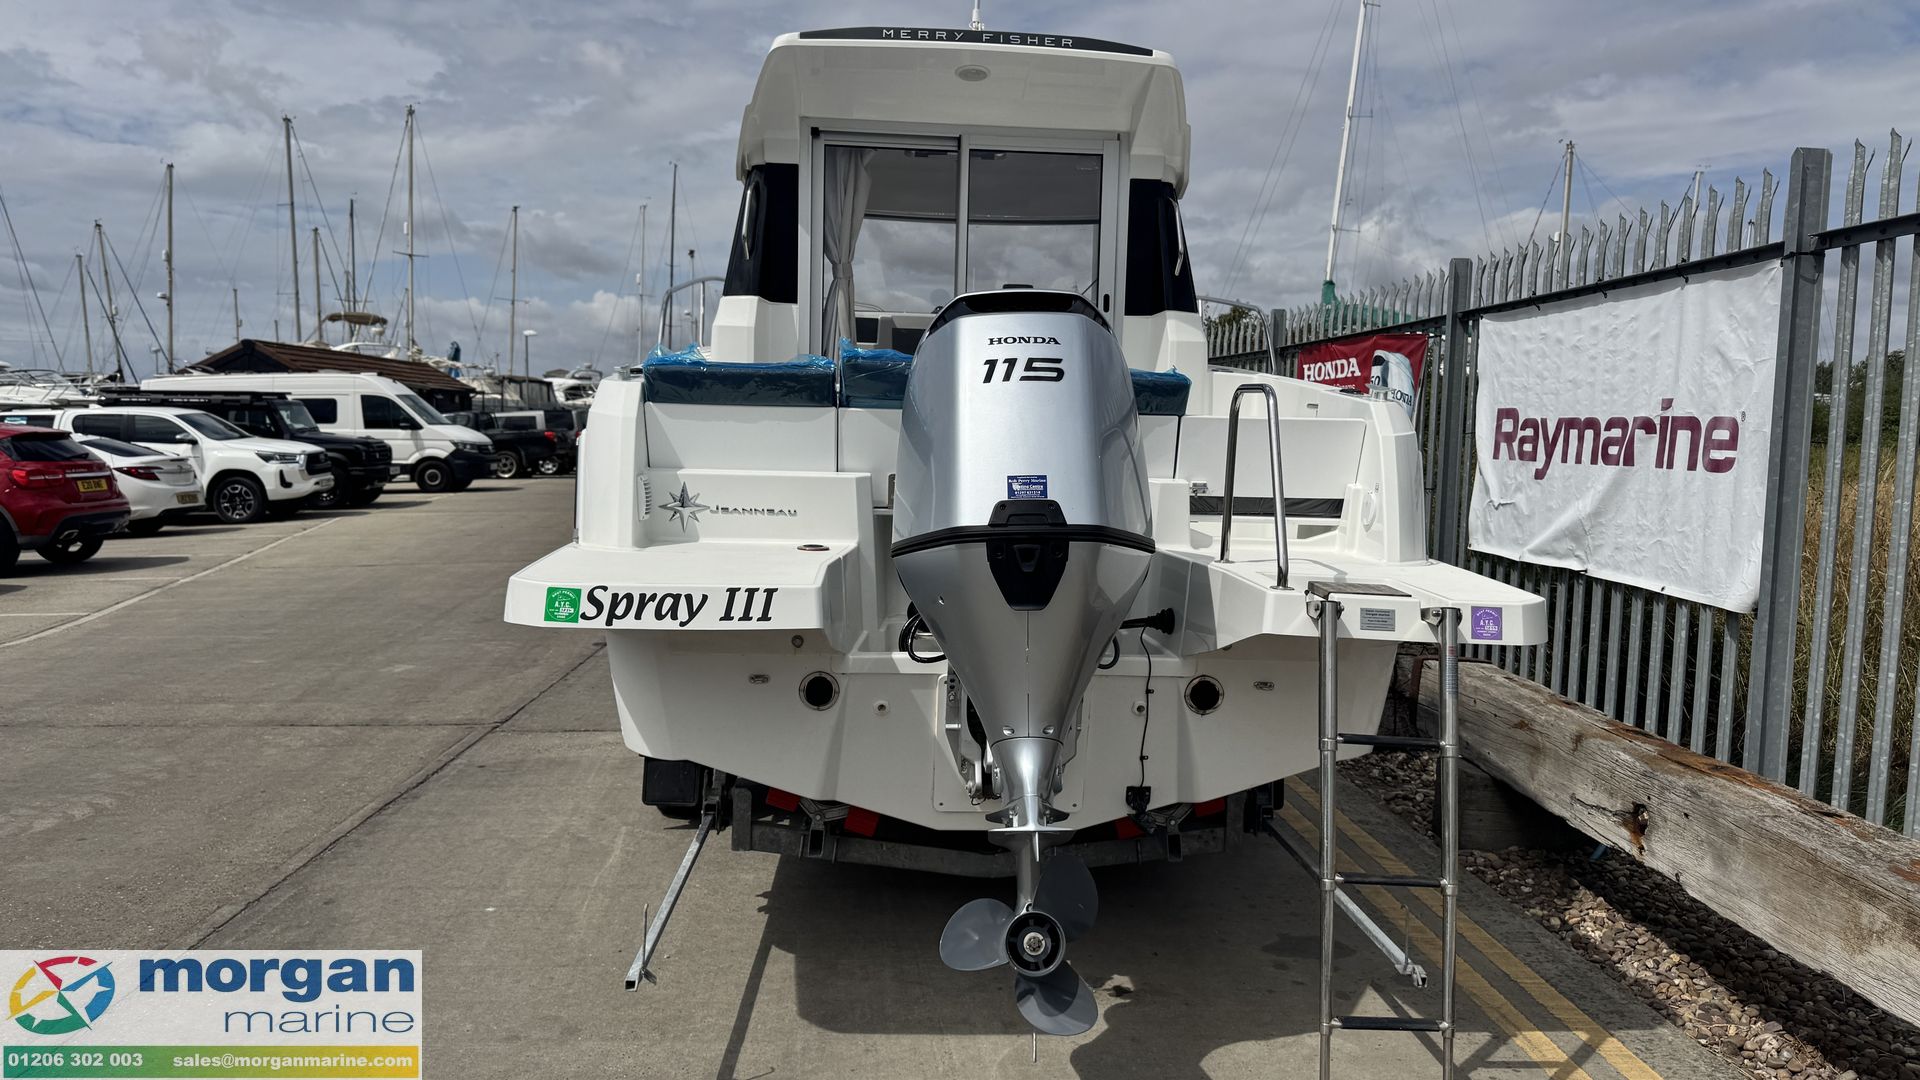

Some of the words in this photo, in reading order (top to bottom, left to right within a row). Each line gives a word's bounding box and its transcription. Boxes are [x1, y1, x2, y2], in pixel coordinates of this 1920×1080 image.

[882, 28, 965, 41] MERRY
[982, 33, 1073, 47] FISHER
[988, 336, 1061, 345] HONDA
[982, 357, 1065, 383] 115
[1303, 357, 1361, 381] HONDA
[1492, 398, 1740, 480] Raymarine
[709, 505, 798, 518] JEANNEAU
[580, 585, 709, 627] Spray
[719, 587, 779, 622] III
